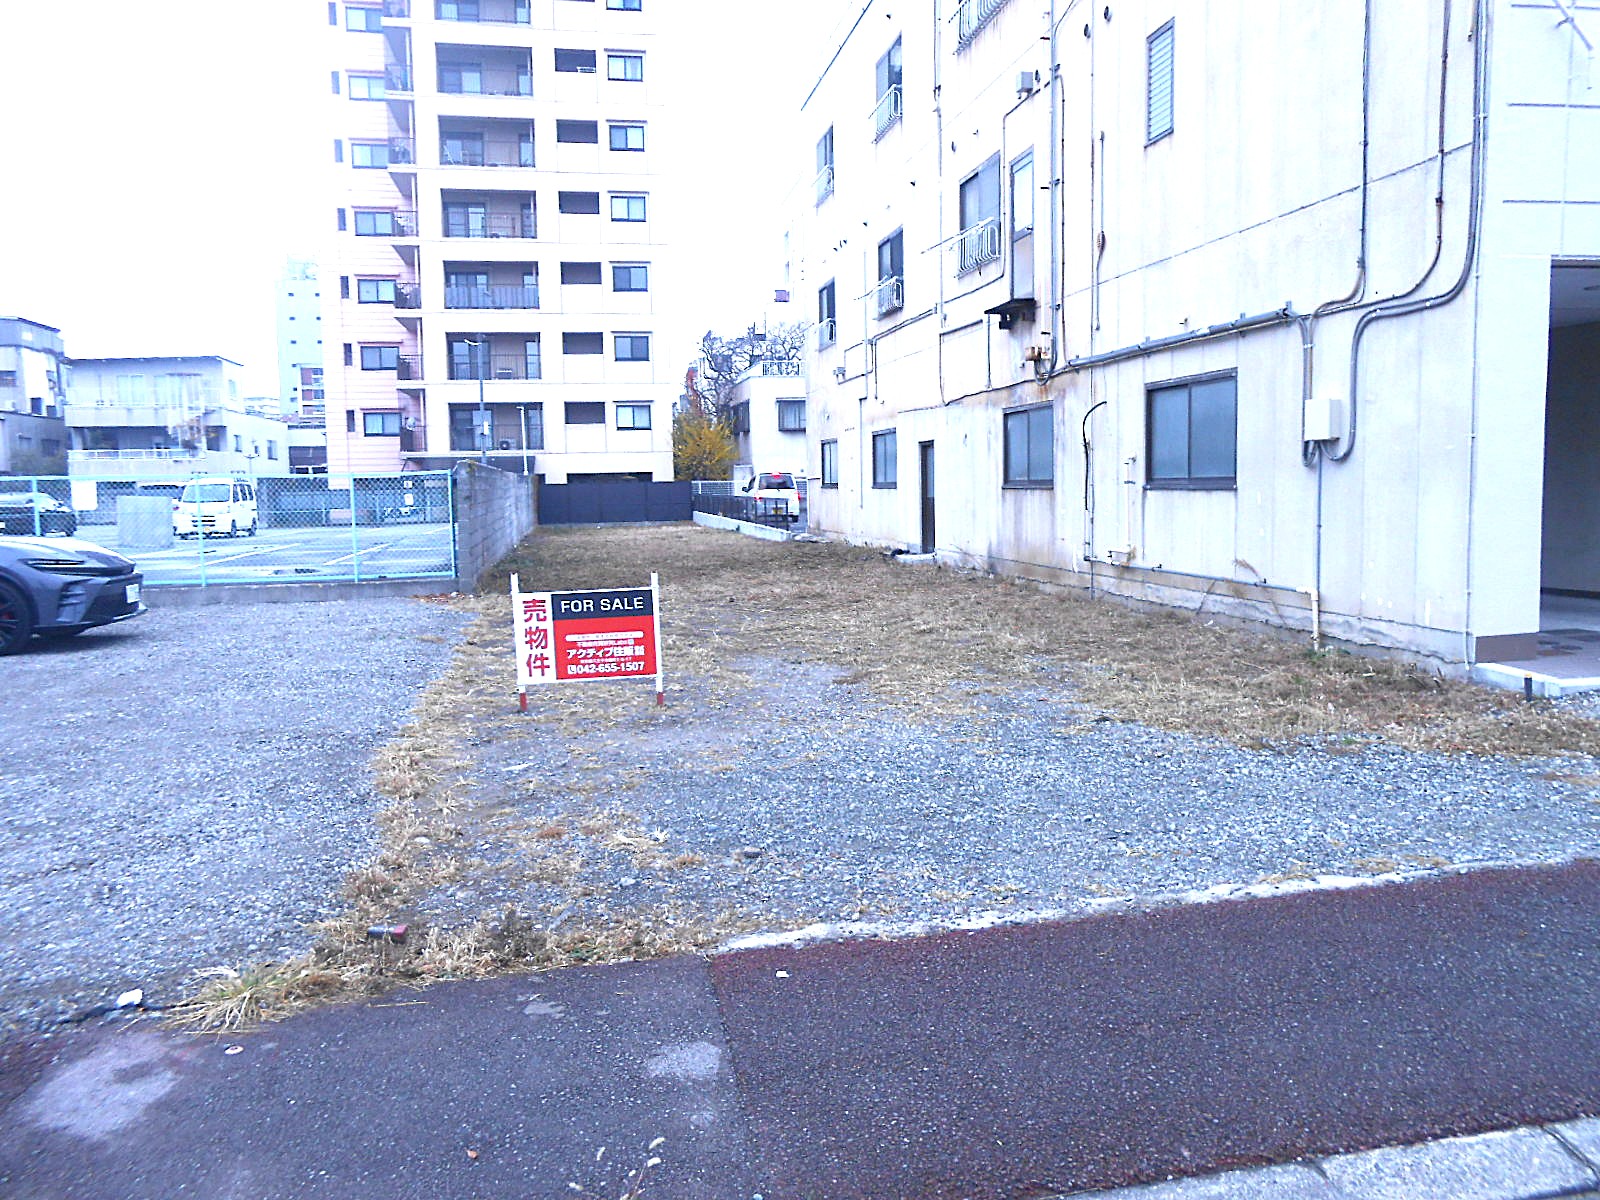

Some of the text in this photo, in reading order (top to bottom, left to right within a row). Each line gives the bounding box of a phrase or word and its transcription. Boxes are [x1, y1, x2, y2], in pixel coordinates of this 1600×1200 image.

[561, 597, 644, 613] FOR SALE
[522, 598, 551, 678] 売物件
[576, 661, 645, 674] 042-655-1507
